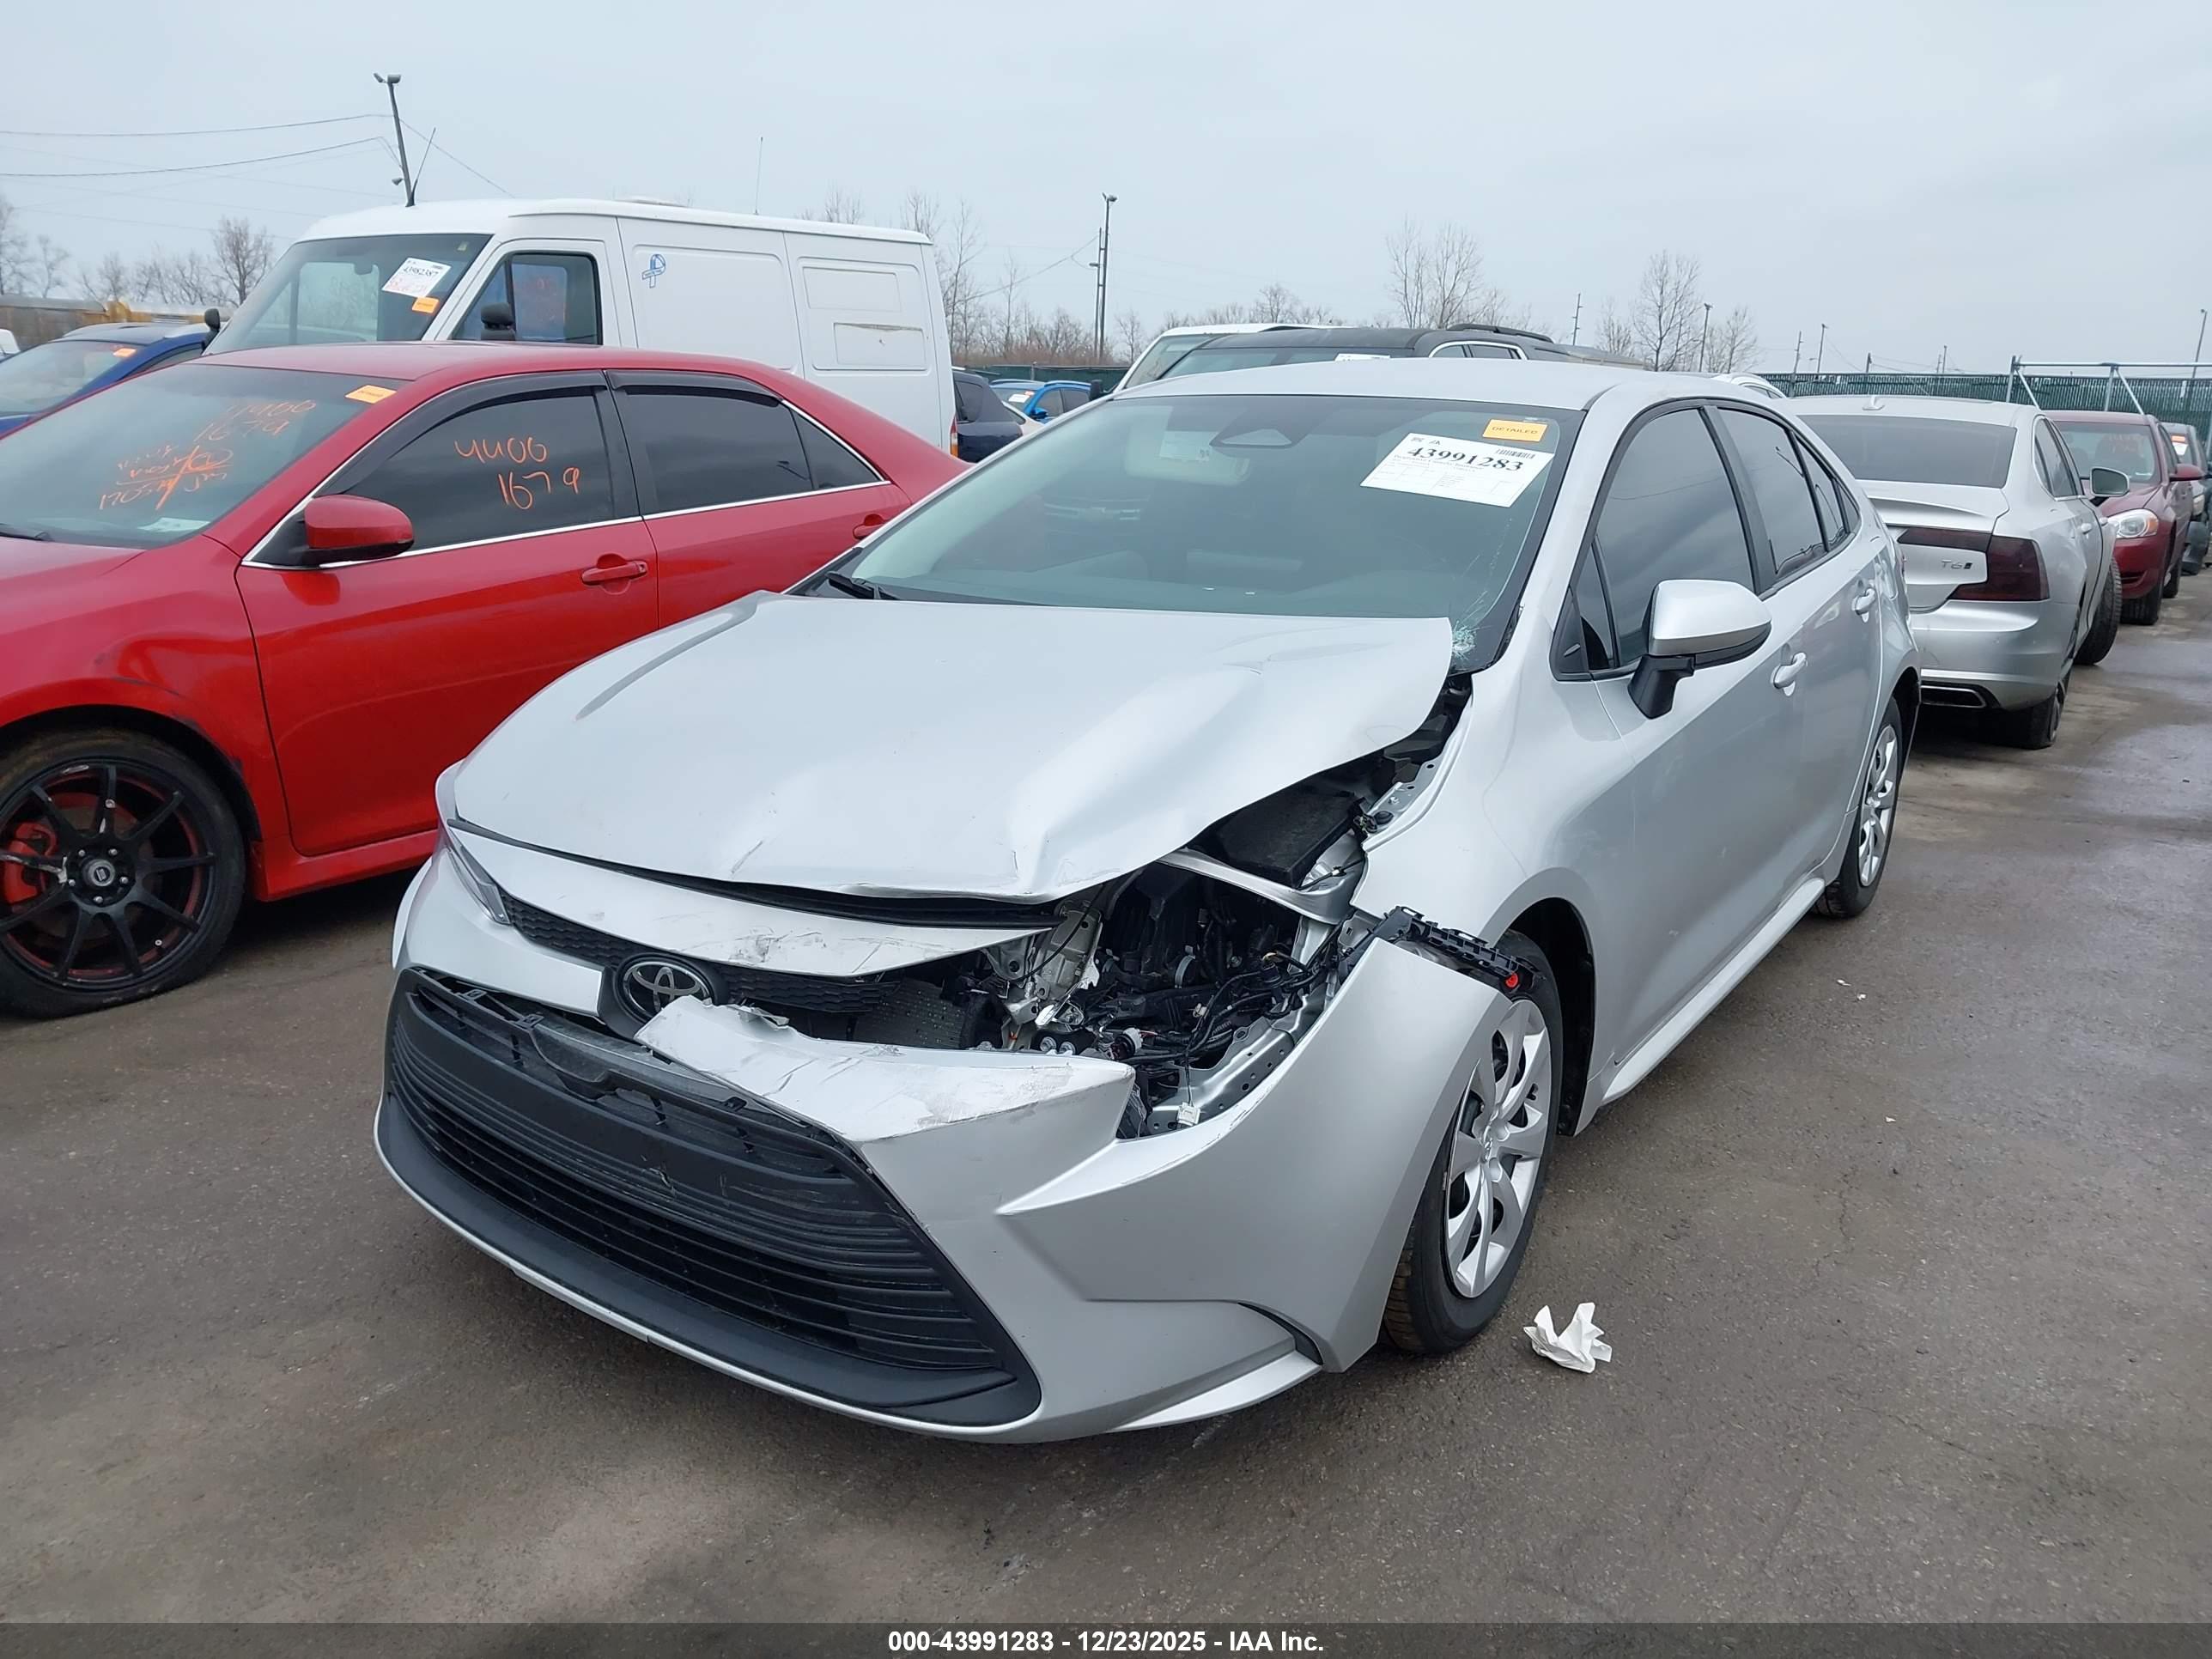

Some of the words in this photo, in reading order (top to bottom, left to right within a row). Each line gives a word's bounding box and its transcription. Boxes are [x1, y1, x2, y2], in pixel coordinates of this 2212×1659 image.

[1492, 426, 1539, 434] DETAILED
[1407, 447, 1524, 472] 43991283
[1942, 558, 1964, 570] T6
